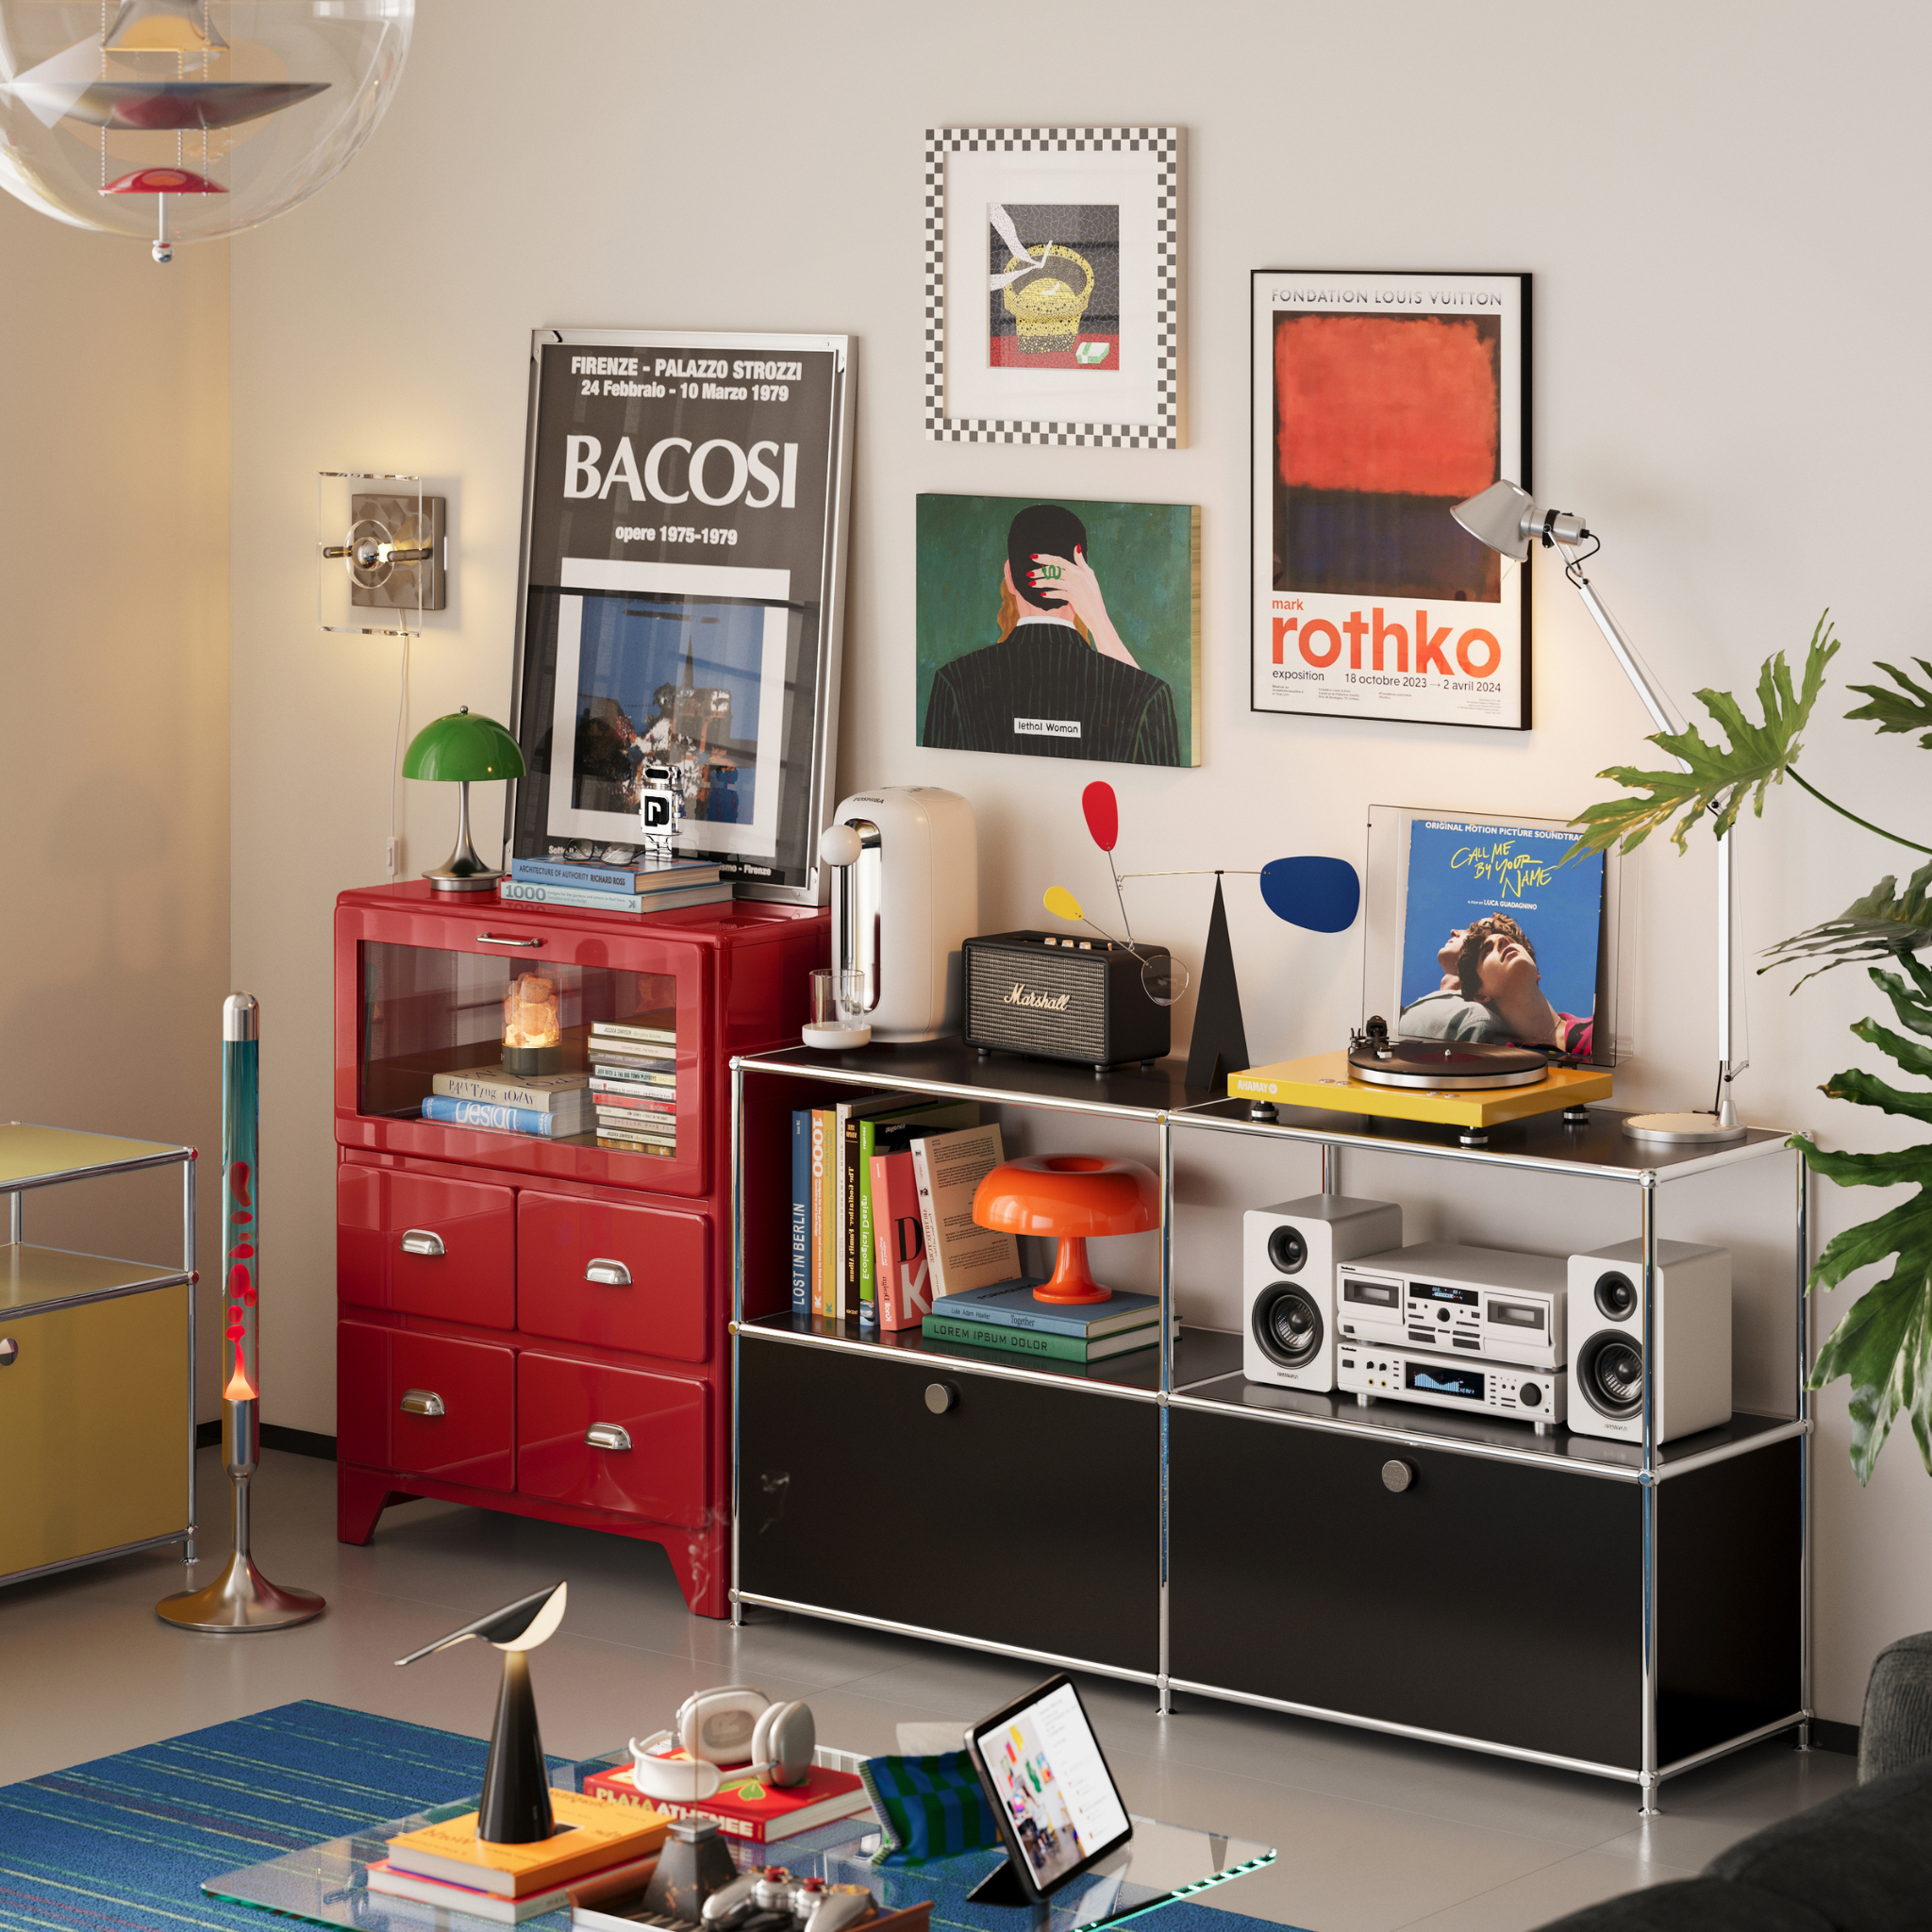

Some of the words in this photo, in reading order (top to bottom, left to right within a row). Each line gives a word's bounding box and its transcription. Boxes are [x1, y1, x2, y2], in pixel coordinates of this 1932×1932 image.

[1272, 289, 1368, 304] FONDATION
[1374, 291, 1422, 304] LOUIS
[1430, 291, 1502, 306] VUITTON
[571, 357, 639, 376] FIRENZE
[655, 358, 728, 378] PALAZZO
[732, 360, 802, 381] STROZZI
[581, 379, 600, 395] 24
[603, 380, 665, 398] Febbraio
[680, 382, 698, 399] 10
[702, 384, 747, 400] Marzo
[752, 385, 789, 402] 1979
[563, 434, 799, 509] BACOSI
[615, 525, 656, 543] opere
[659, 525, 738, 545] 1975-1979
[1272, 598, 1304, 611] mark
[1272, 607, 1502, 678] rothko
[1273, 670, 1324, 682] exposition
[1345, 673, 1357, 684] 18
[1358, 674, 1400, 687] octobre
[1403, 676, 1427, 689] 2023
[1443, 679, 1450, 690] 2
[1452, 678, 1474, 691] avril
[1476, 681, 1502, 693] 2024
[1018, 722, 1043, 731] lethal
[1046, 723, 1078, 734] Woman
[1425, 822, 1463, 832] ORIGINAL
[1465, 824, 1497, 834] MOTION
[1499, 827, 1533, 838] PICTURE
[1450, 847, 1490, 869] CALL
[1491, 841, 1515, 863] ME
[519, 865, 554, 876] ARCHITECTURE
[562, 871, 589, 881] AUTHORITY
[590, 874, 612, 885] RICHARD
[613, 877, 625, 886] ROSS
[1502, 865, 1558, 898] NAME
[506, 885, 546, 901] 1000
[1484, 899, 1499, 908] LUCA
[1499, 901, 1538, 911] GUADAGNINO
[1004, 982, 1071, 1011] Marshall
[1237, 1079, 1269, 1093] AHAMAY
[812, 1117, 824, 1177] 1000
[792, 1203, 806, 1252] BERLIN
[894, 1216, 922, 1263] D
[792, 1256, 806, 1267] IN
[792, 1270, 806, 1306] LOST
[900, 1259, 932, 1320] K
[975, 1311, 991, 1320] Hawker
[1009, 1314, 1035, 1327] Together
[933, 1324, 970, 1339] LOREM
[974, 1329, 1007, 1345] IPSUM
[1011, 1337, 1048, 1351] DOLOR
[596, 1788, 655, 1811] PLAZA
